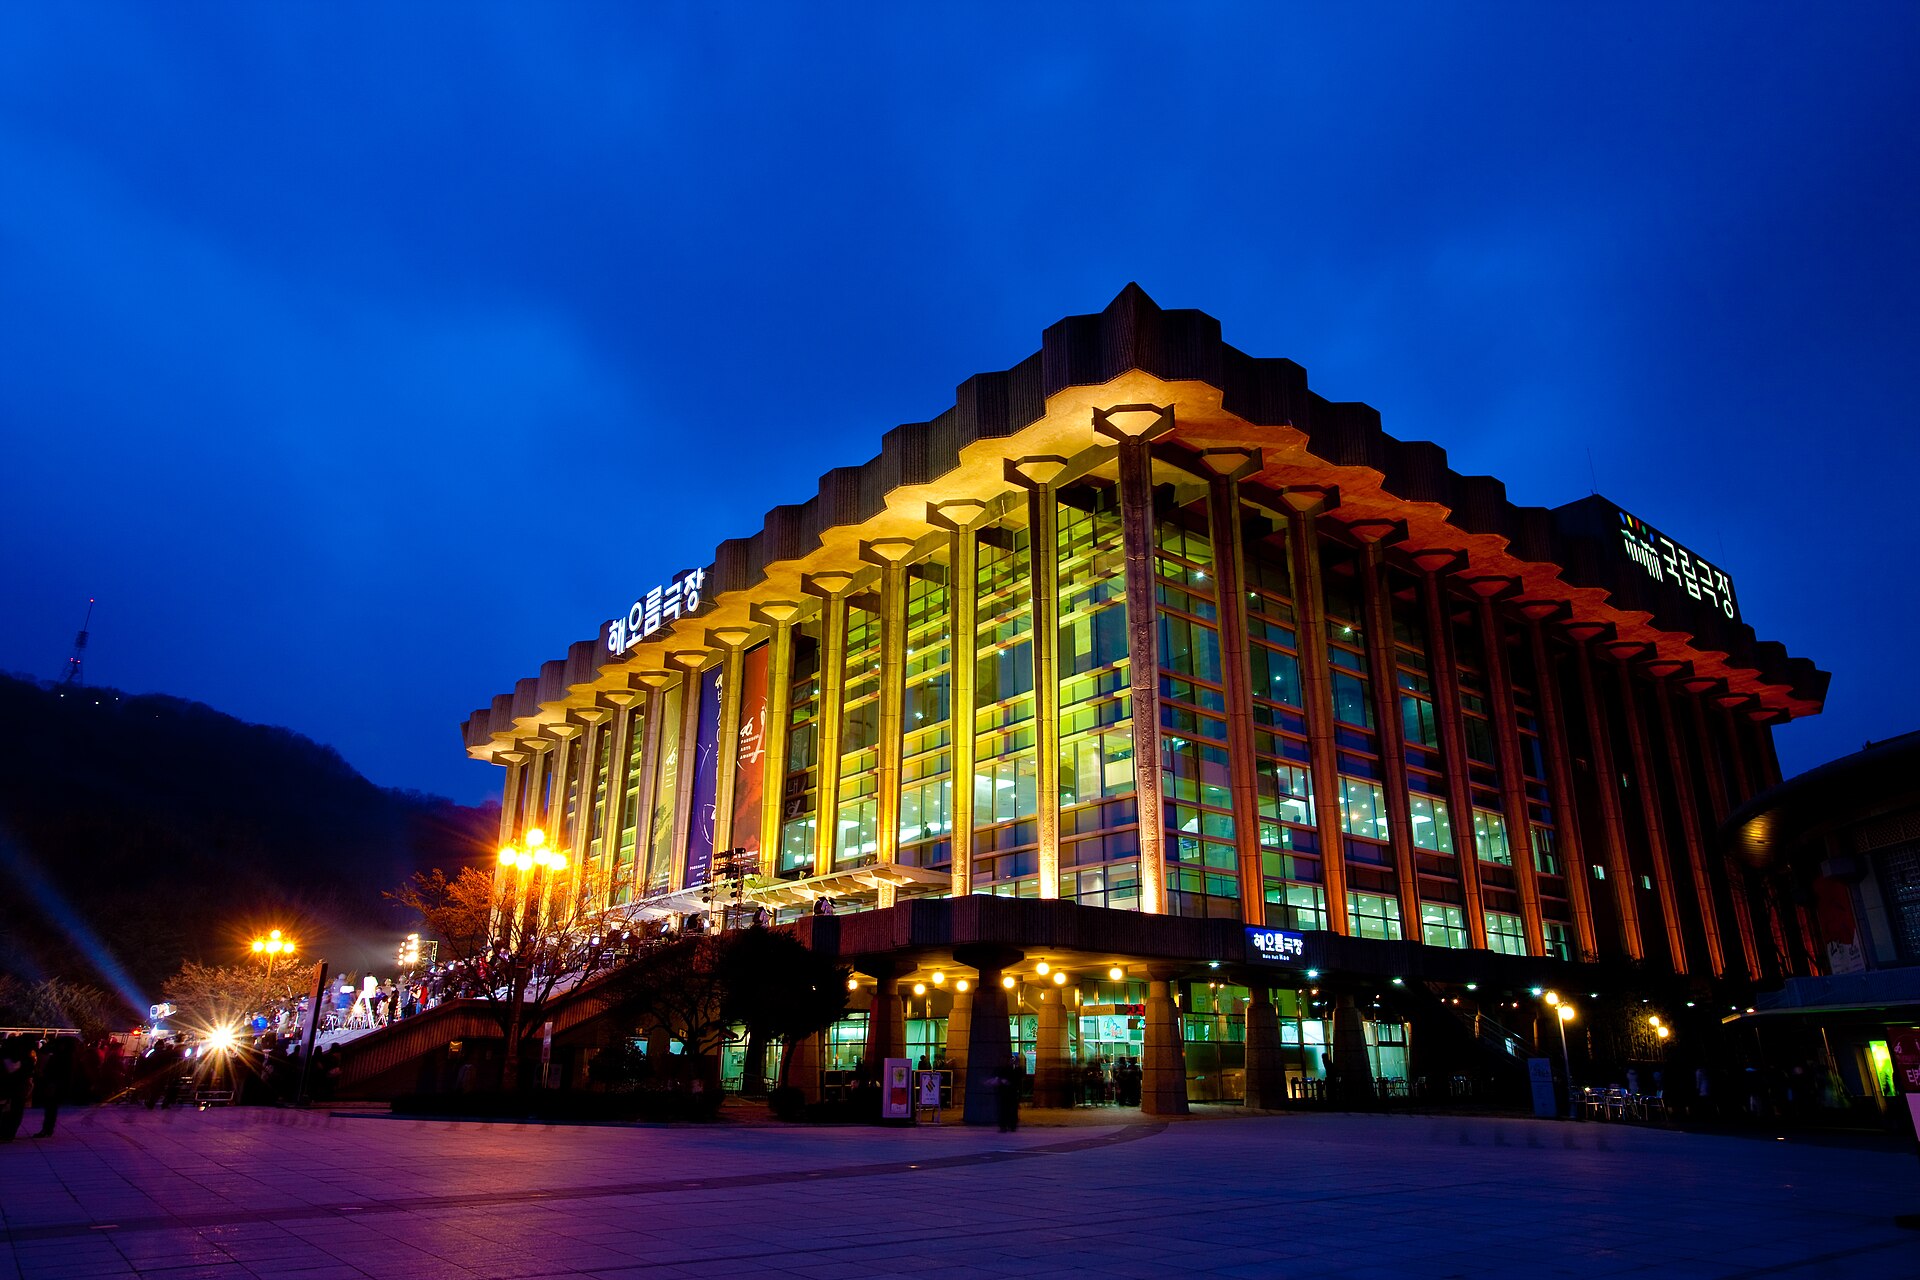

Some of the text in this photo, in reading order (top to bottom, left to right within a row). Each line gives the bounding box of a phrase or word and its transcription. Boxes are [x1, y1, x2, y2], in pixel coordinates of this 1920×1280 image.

[608, 567, 705, 655] 해오름극장
[1660, 537, 1734, 619] 국립극장
[1254, 933, 1303, 955] 해오름극장
